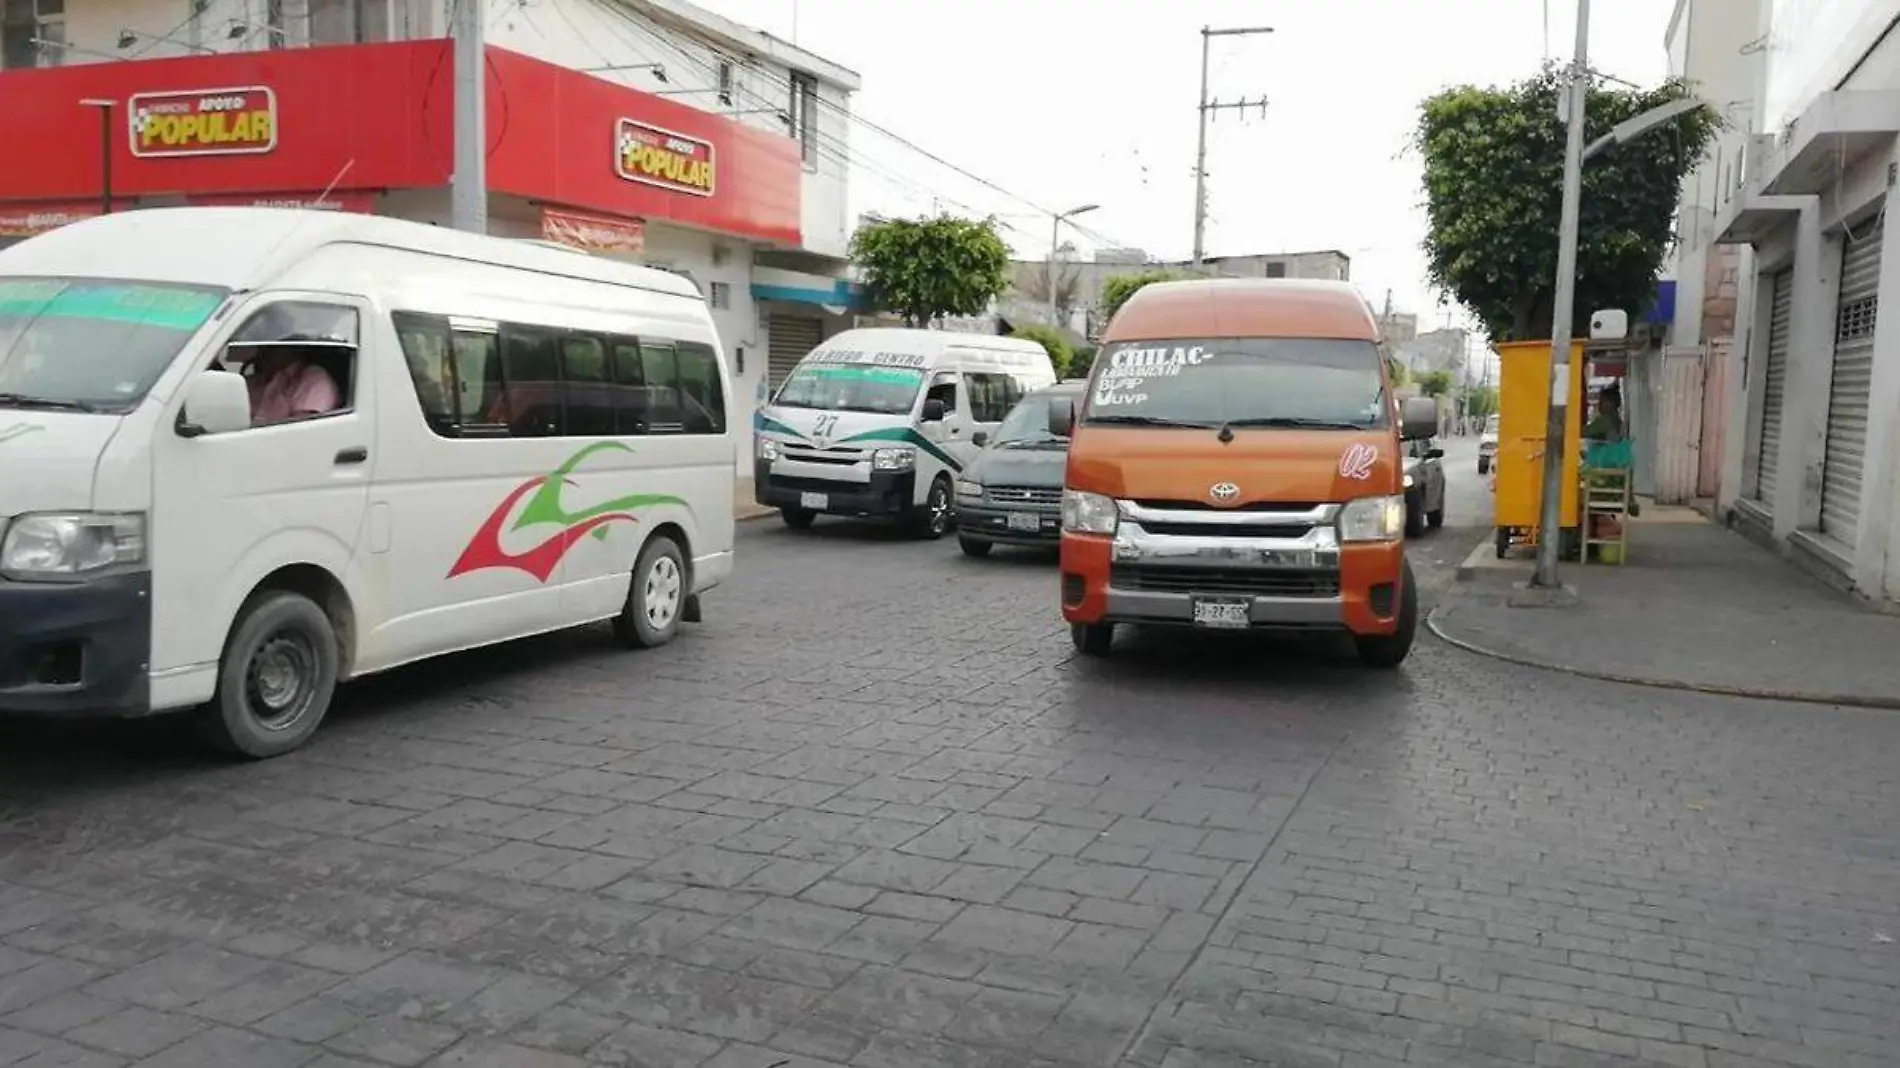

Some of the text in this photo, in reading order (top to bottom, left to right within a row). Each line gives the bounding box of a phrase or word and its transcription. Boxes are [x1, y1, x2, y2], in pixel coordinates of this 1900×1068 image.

[142, 110, 270, 147] POPULAR
[625, 140, 712, 187] POPULAR
[812, 414, 840, 437] 27
